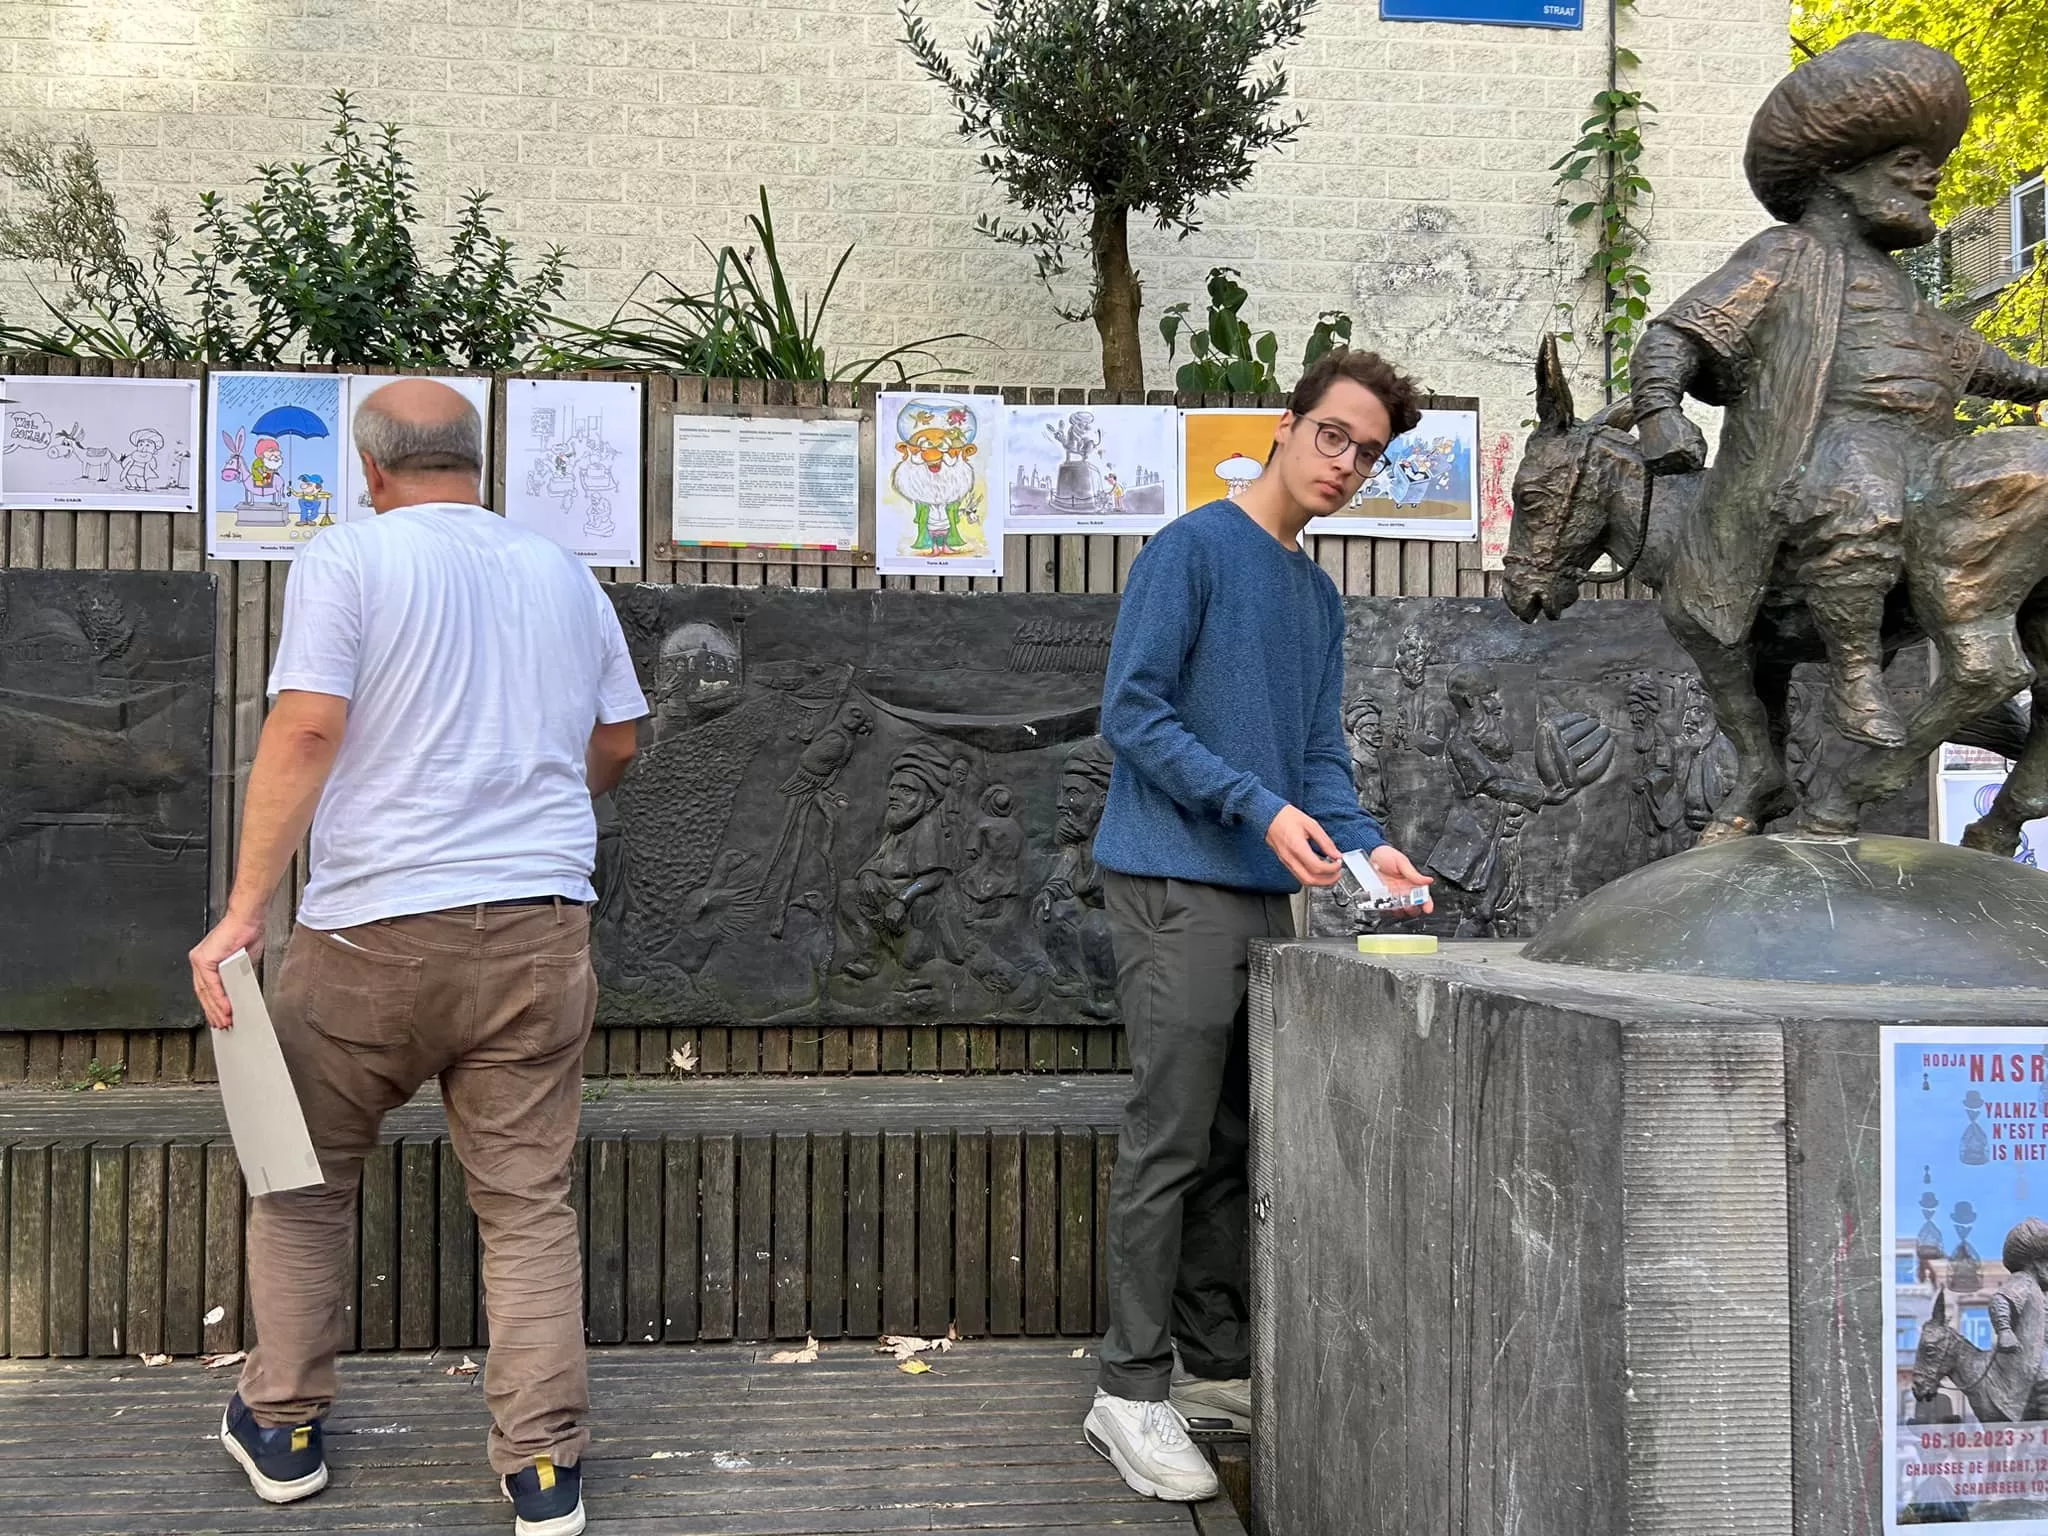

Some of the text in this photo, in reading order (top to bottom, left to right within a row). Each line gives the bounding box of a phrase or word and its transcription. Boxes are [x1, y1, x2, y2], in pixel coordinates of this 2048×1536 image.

[1543, 5, 1576, 16] STRAAT
[1923, 1053, 2046, 1083] HODJA NASR
[1985, 1102, 2037, 1118] YALNIZ
[1992, 1123, 2035, 1139] N'EST
[1993, 1144, 2047, 1160] IS NIET
[1921, 1430, 2014, 1449] 06.10.2023
[1906, 1462, 1964, 1476] CHAUSSEE
[1969, 1461, 1984, 1474] DE
[1954, 1480, 2026, 1496] SCHAERBEEK
